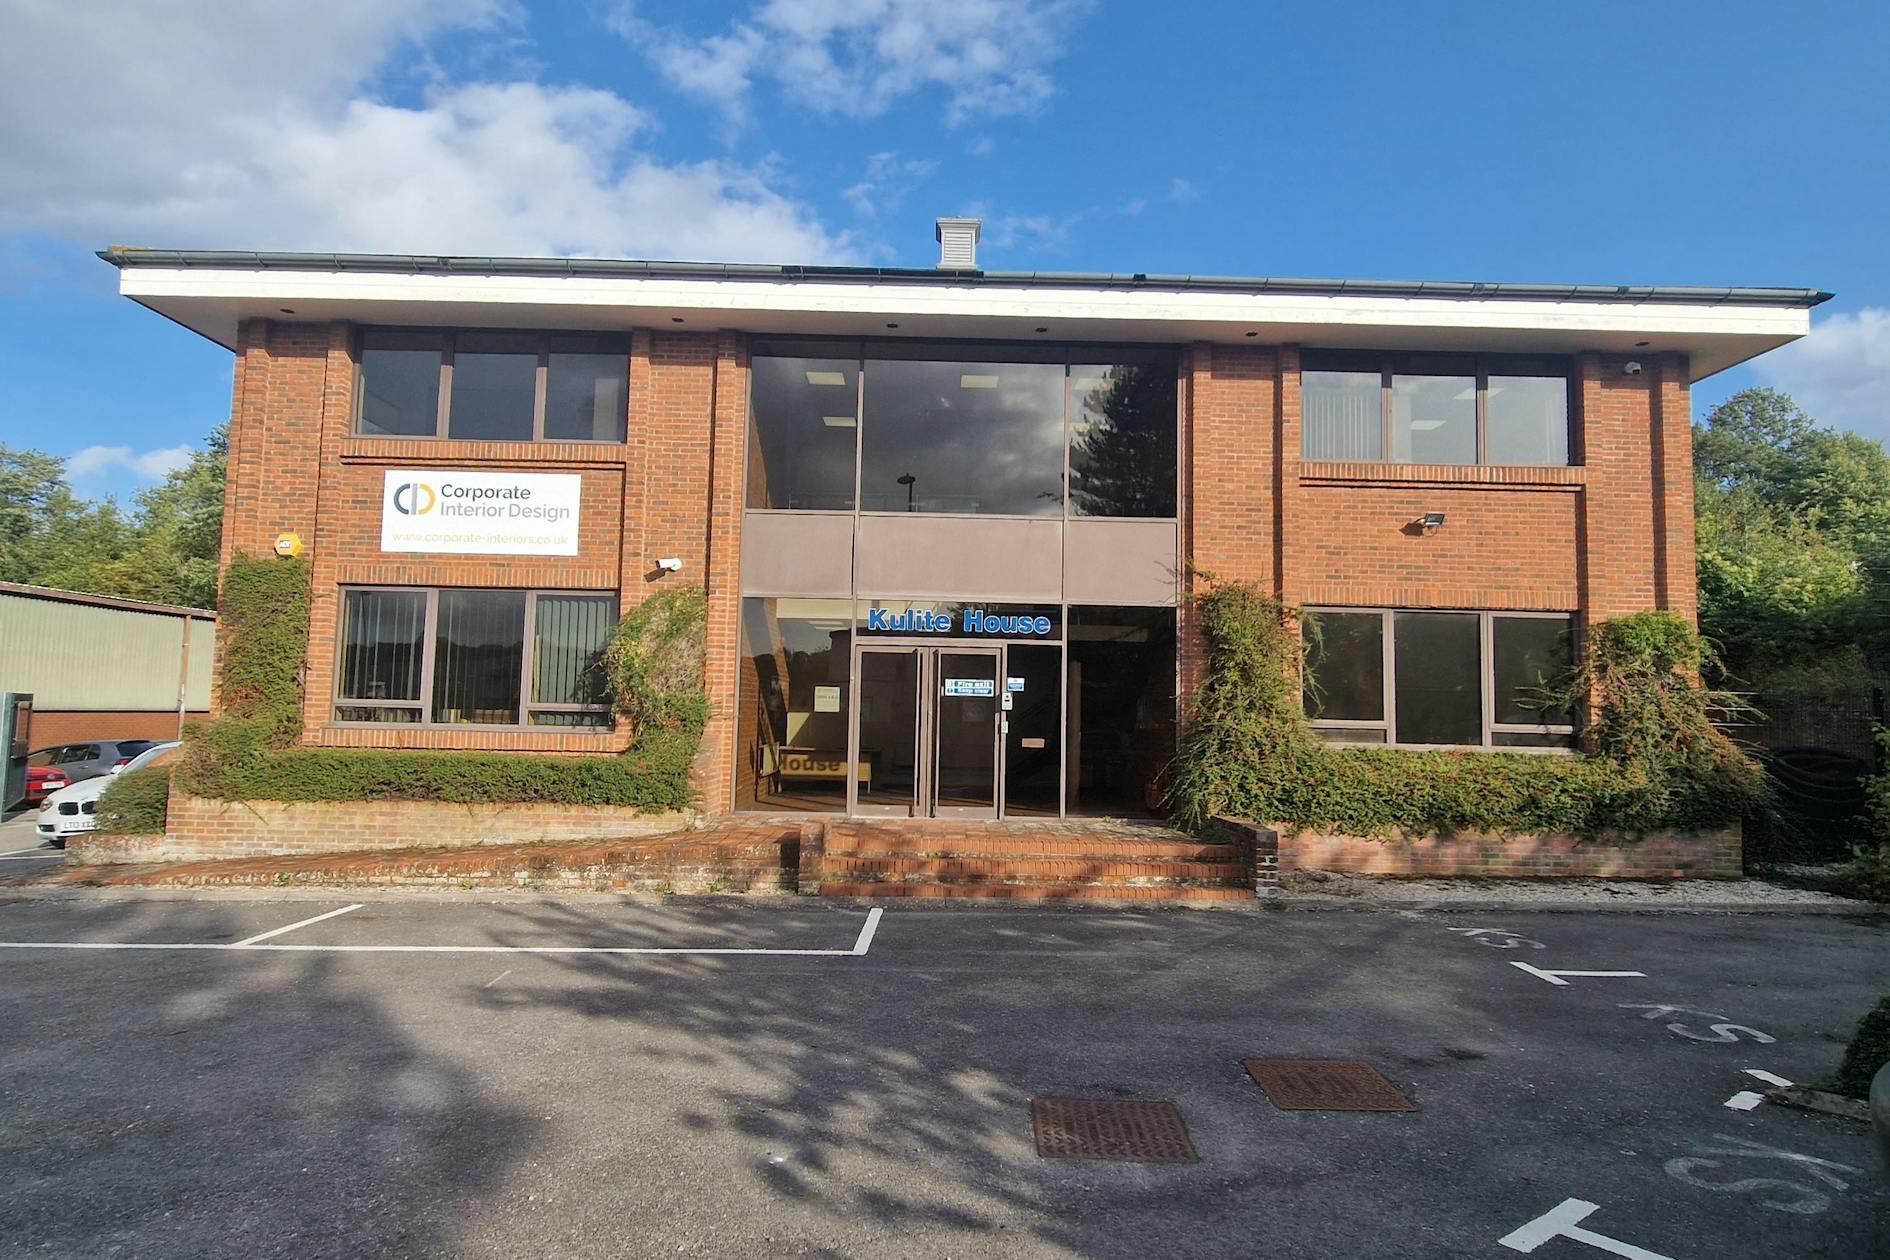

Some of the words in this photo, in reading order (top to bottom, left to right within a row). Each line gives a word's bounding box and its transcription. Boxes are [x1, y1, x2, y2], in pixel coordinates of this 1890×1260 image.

[441, 483, 531, 501] Corporate
[440, 501, 505, 518] Interior
[508, 503, 570, 522] Design
[392, 532, 568, 546] www.corporate-interiors.co.uk
[868, 607, 951, 632] Kulite
[963, 609, 1051, 634] House
